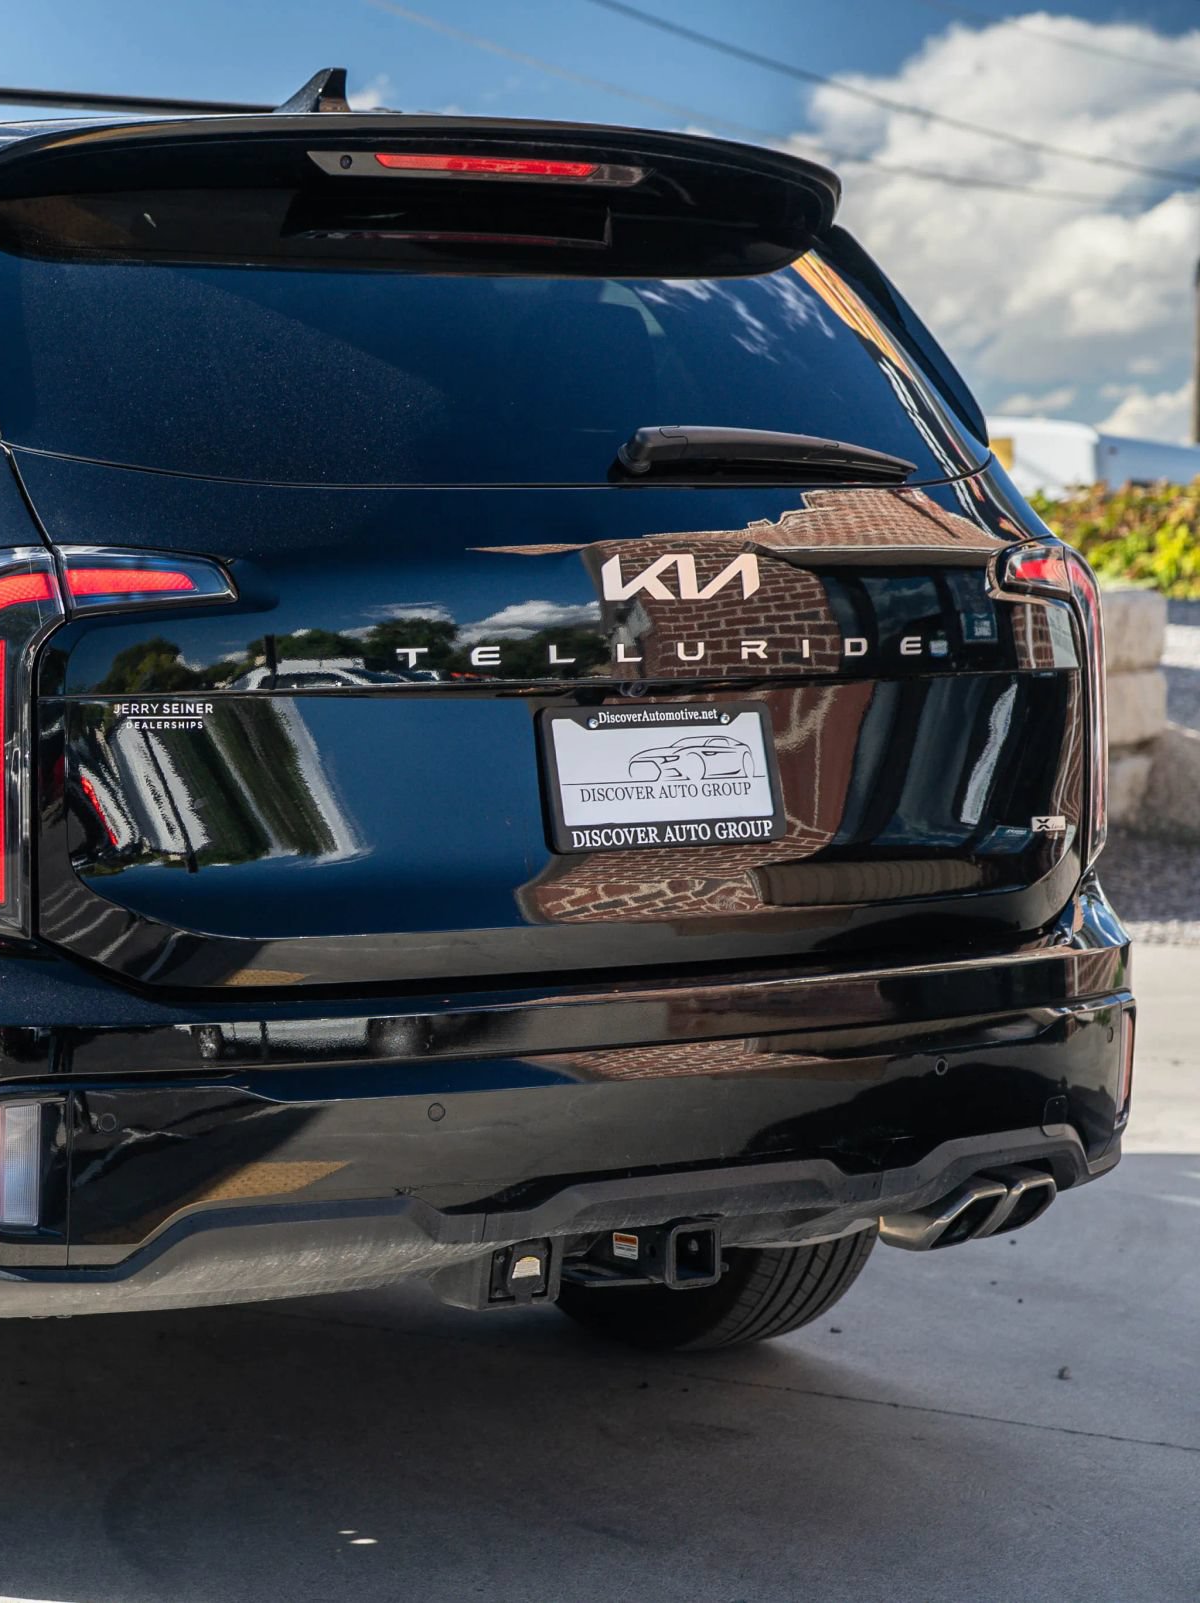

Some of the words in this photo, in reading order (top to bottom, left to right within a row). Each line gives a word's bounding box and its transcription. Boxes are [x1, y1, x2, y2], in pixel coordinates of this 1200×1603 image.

[396, 635, 924, 669] TELLURIDE
[113, 703, 159, 714] JERRY
[162, 703, 214, 714] SEINER
[597, 708, 718, 724] DiscoverAutomotive.net
[126, 721, 203, 730] DEALERSHIPS
[580, 786, 656, 802] DISCOVER
[658, 784, 698, 799] AUTO
[701, 781, 752, 798] GROUP
[571, 826, 661, 848] DISCOVER
[663, 823, 711, 843] AUTO
[714, 820, 773, 839] GROUP
